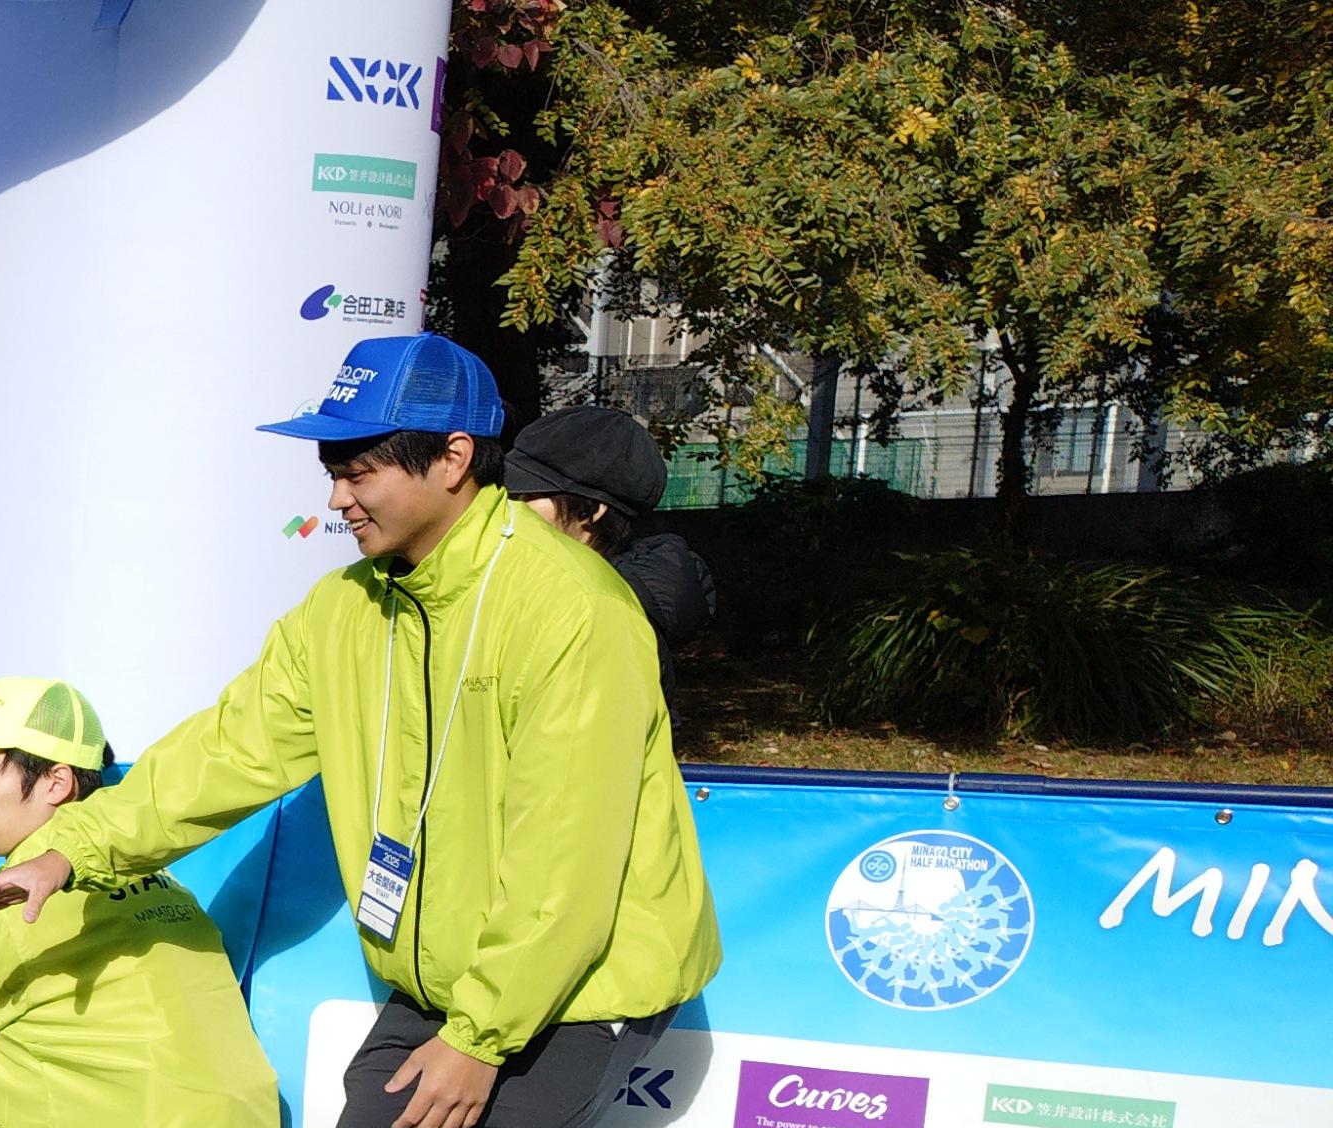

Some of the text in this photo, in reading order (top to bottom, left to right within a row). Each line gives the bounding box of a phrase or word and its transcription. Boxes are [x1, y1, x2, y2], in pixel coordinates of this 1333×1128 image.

[327, 56, 422, 110] NOK
[329, 201, 402, 219] NOLI et NORI
[343, 294, 405, 318] 合田工務店
[353, 368, 378, 382] CITY
[329, 385, 358, 403] AFF
[324, 522, 352, 534] NISH
[383, 852, 400, 868] 2025
[911, 845, 973, 858] MINATO CITY
[910, 857, 988, 871] HALF MARATHON
[1099, 846, 1333, 946] MIN
[134, 905, 173, 923] MINATO
[769, 1074, 887, 1120] Curves
[755, 1115, 775, 1128] The
[1036, 1102, 1167, 1128] 笠井設計株式会社
